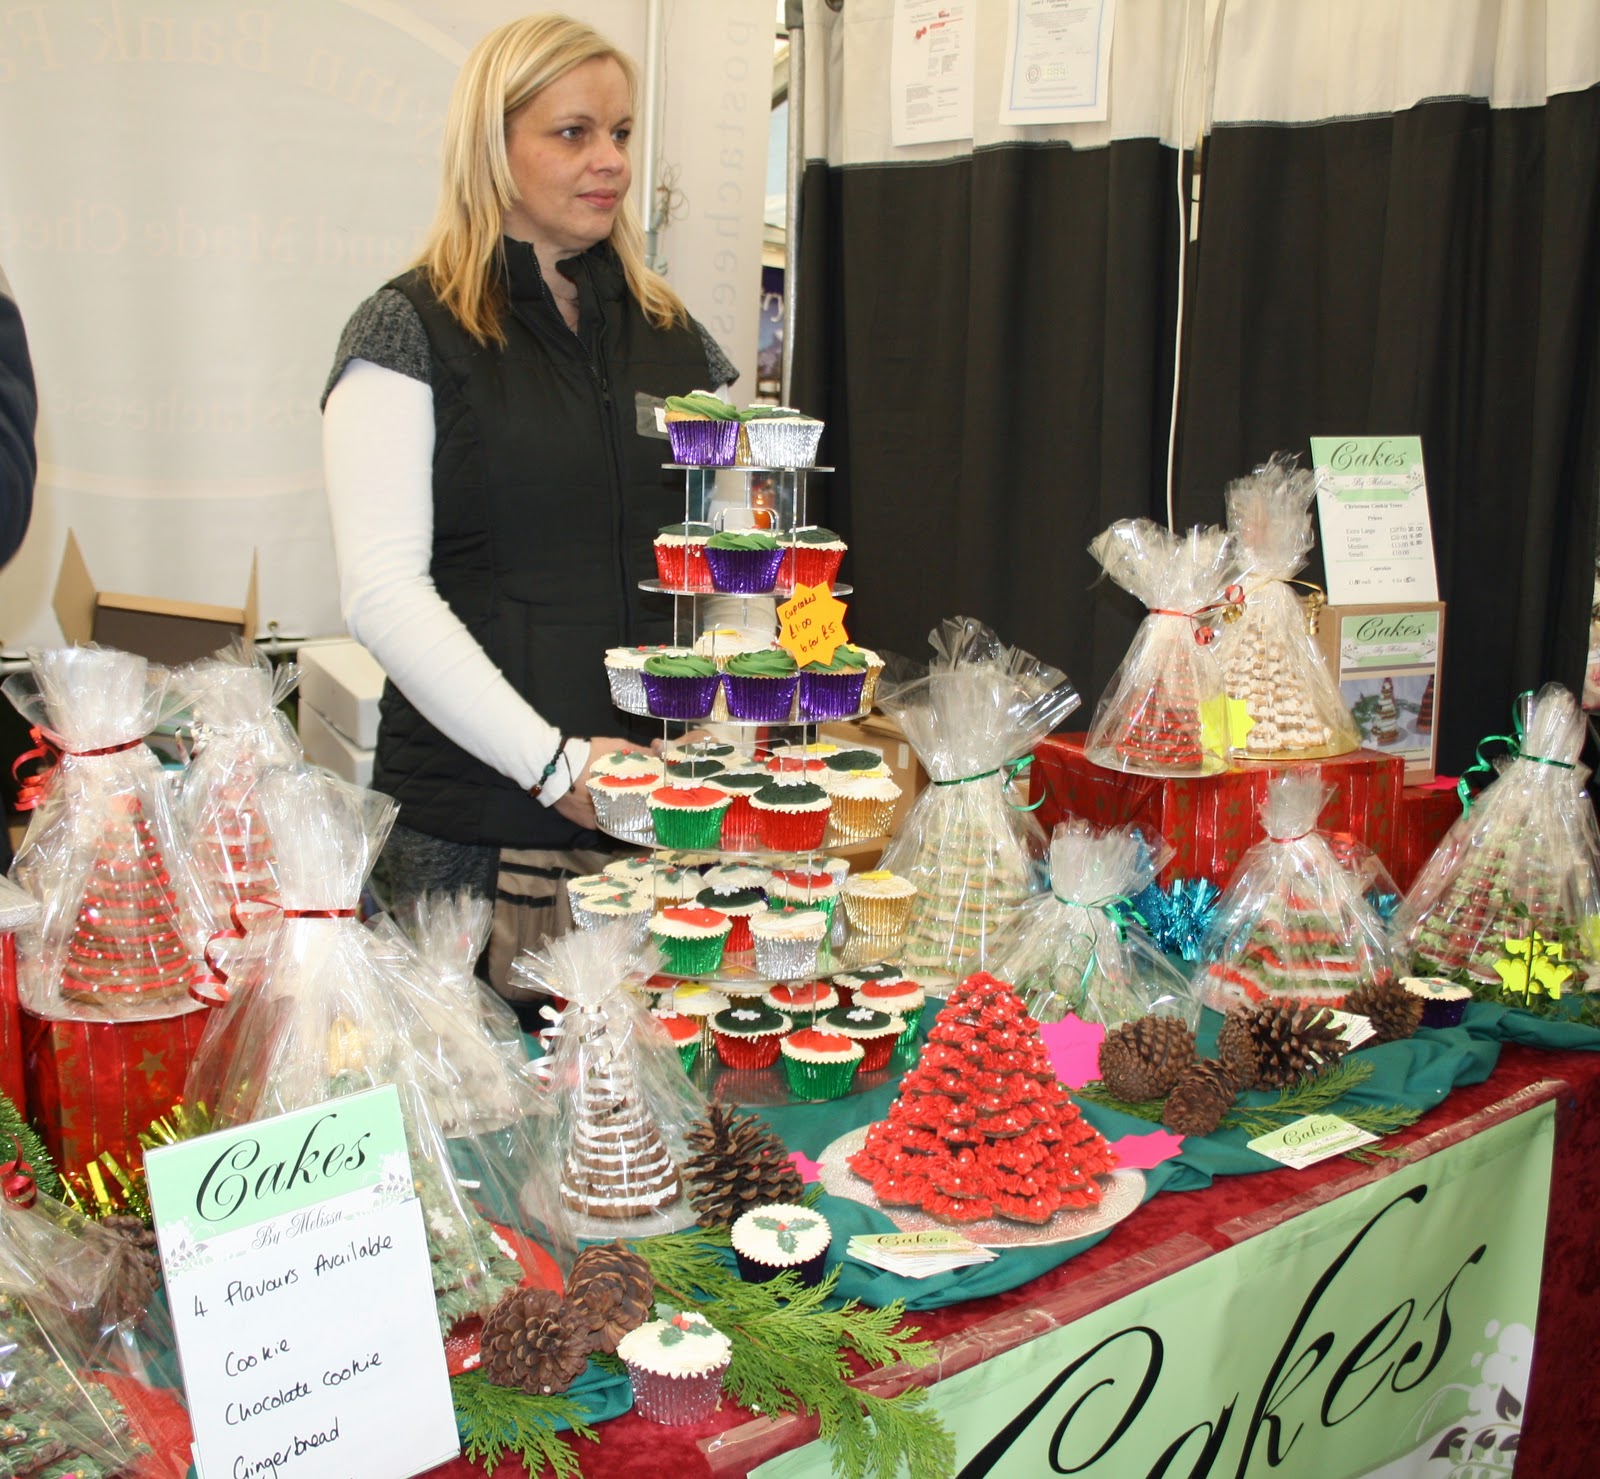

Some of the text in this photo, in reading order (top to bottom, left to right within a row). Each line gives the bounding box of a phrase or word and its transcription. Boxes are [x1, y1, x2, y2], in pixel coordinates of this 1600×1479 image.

[1330, 440, 1407, 471] Cakes
[1352, 477, 1365, 488] By
[808, 636, 819, 650] for
[1356, 614, 1425, 642] Cakes
[1283, 1119, 1338, 1147] Cakes
[195, 1113, 371, 1222] Cakes
[251, 1207, 343, 1250] By Melissa
[876, 1232, 949, 1247] Cakes
[193, 1294, 208, 1318] 4
[313, 1234, 395, 1277] Available
[954, 1184, 1487, 1479] Cakes
[225, 1338, 291, 1377] Cookie
[225, 1380, 313, 1426] Chocolate
[233, 1416, 340, 1479] Gingerbread
